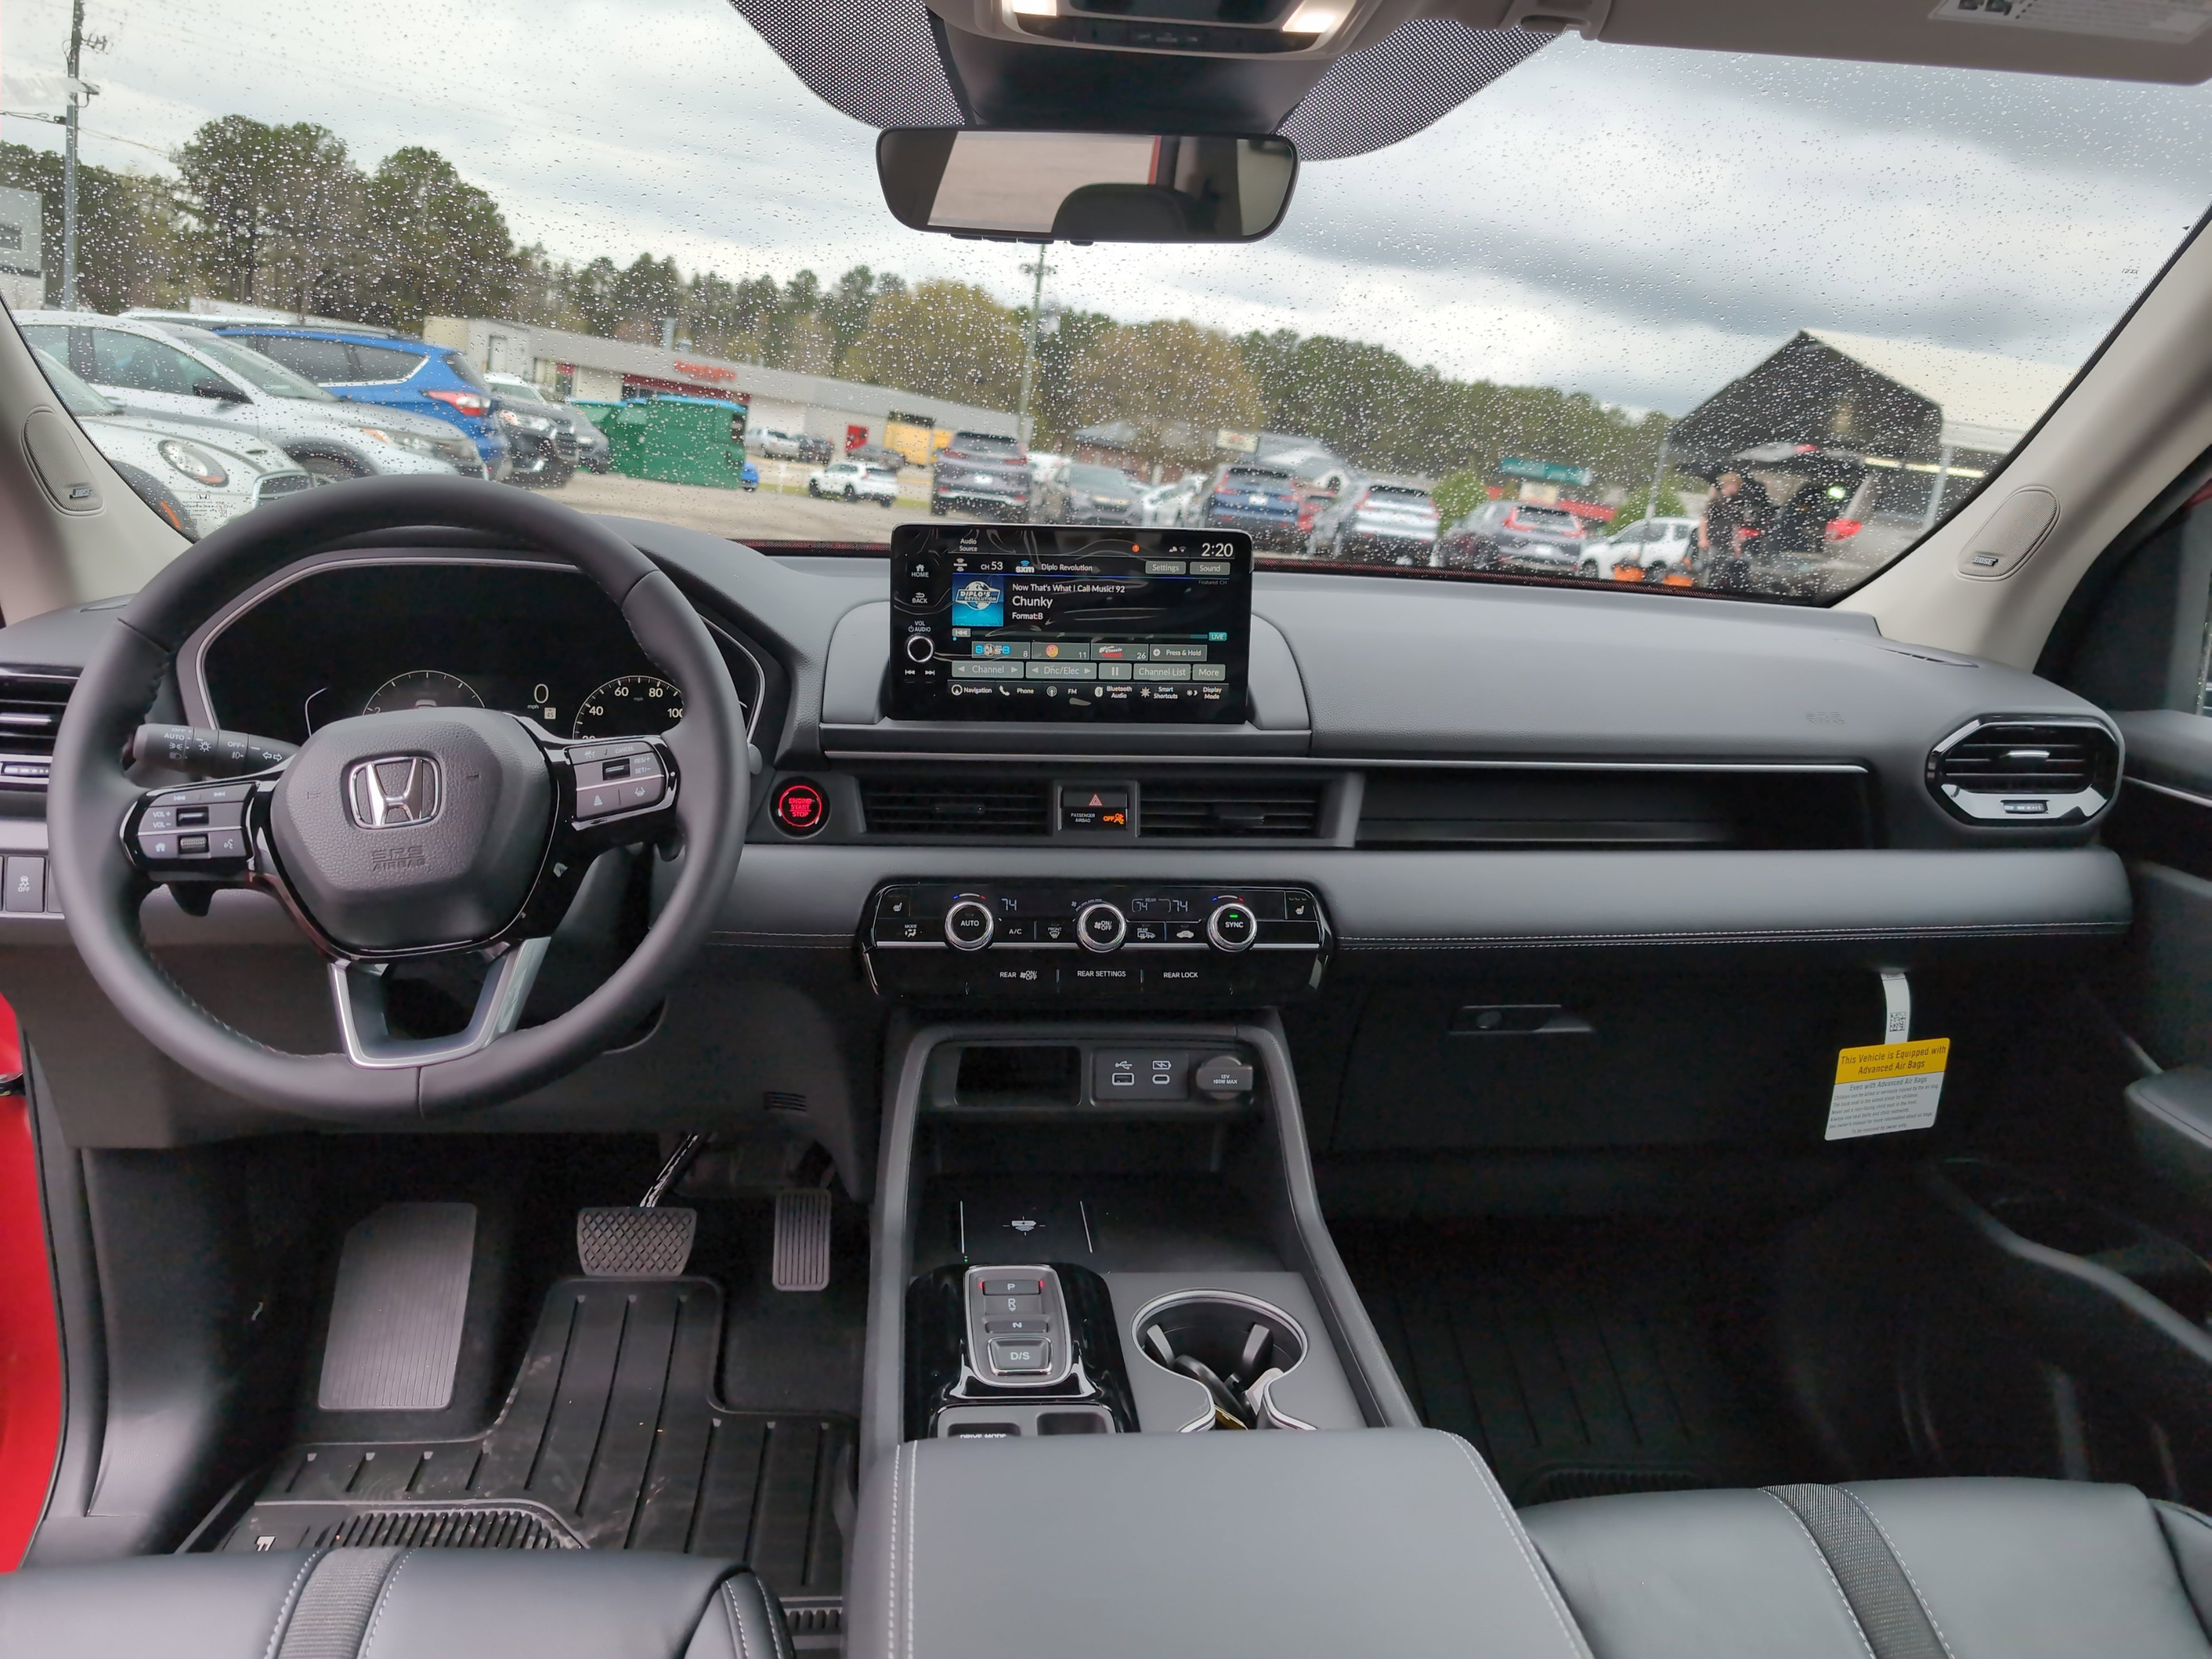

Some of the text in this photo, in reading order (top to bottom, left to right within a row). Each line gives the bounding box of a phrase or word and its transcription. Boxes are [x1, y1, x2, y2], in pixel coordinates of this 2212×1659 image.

[1201, 543, 1233, 557] 2:20
[991, 561, 1003, 571] 53
[1041, 563, 1058, 571] Diplo
[1012, 596, 1053, 609] Chunky
[972, 665, 1004, 674] Channel
[1044, 666, 1079, 675] Dnc/Elec
[1139, 668, 1186, 676] Channel List
[1199, 668, 1219, 676] More
[534, 684, 549, 704] 0
[614, 687, 629, 697] 60
[649, 688, 663, 697] 80
[589, 706, 603, 716] 40
[1002, 898, 1017, 911] 74
[1136, 902, 1148, 911] 74
[1172, 899, 1188, 912] 74
[1841, 1056, 1856, 1065] This
[1859, 1053, 1885, 1063] Vehicle
[1896, 1047, 1929, 1058] Equipped
[1931, 1045, 1946, 1054] with
[1858, 1060, 1925, 1075] Advanced Air Bags
[1877, 1078, 1903, 1088] Advanced
[1008, 1298, 1016, 1308] R
[1010, 1351, 1030, 1361] D/S
